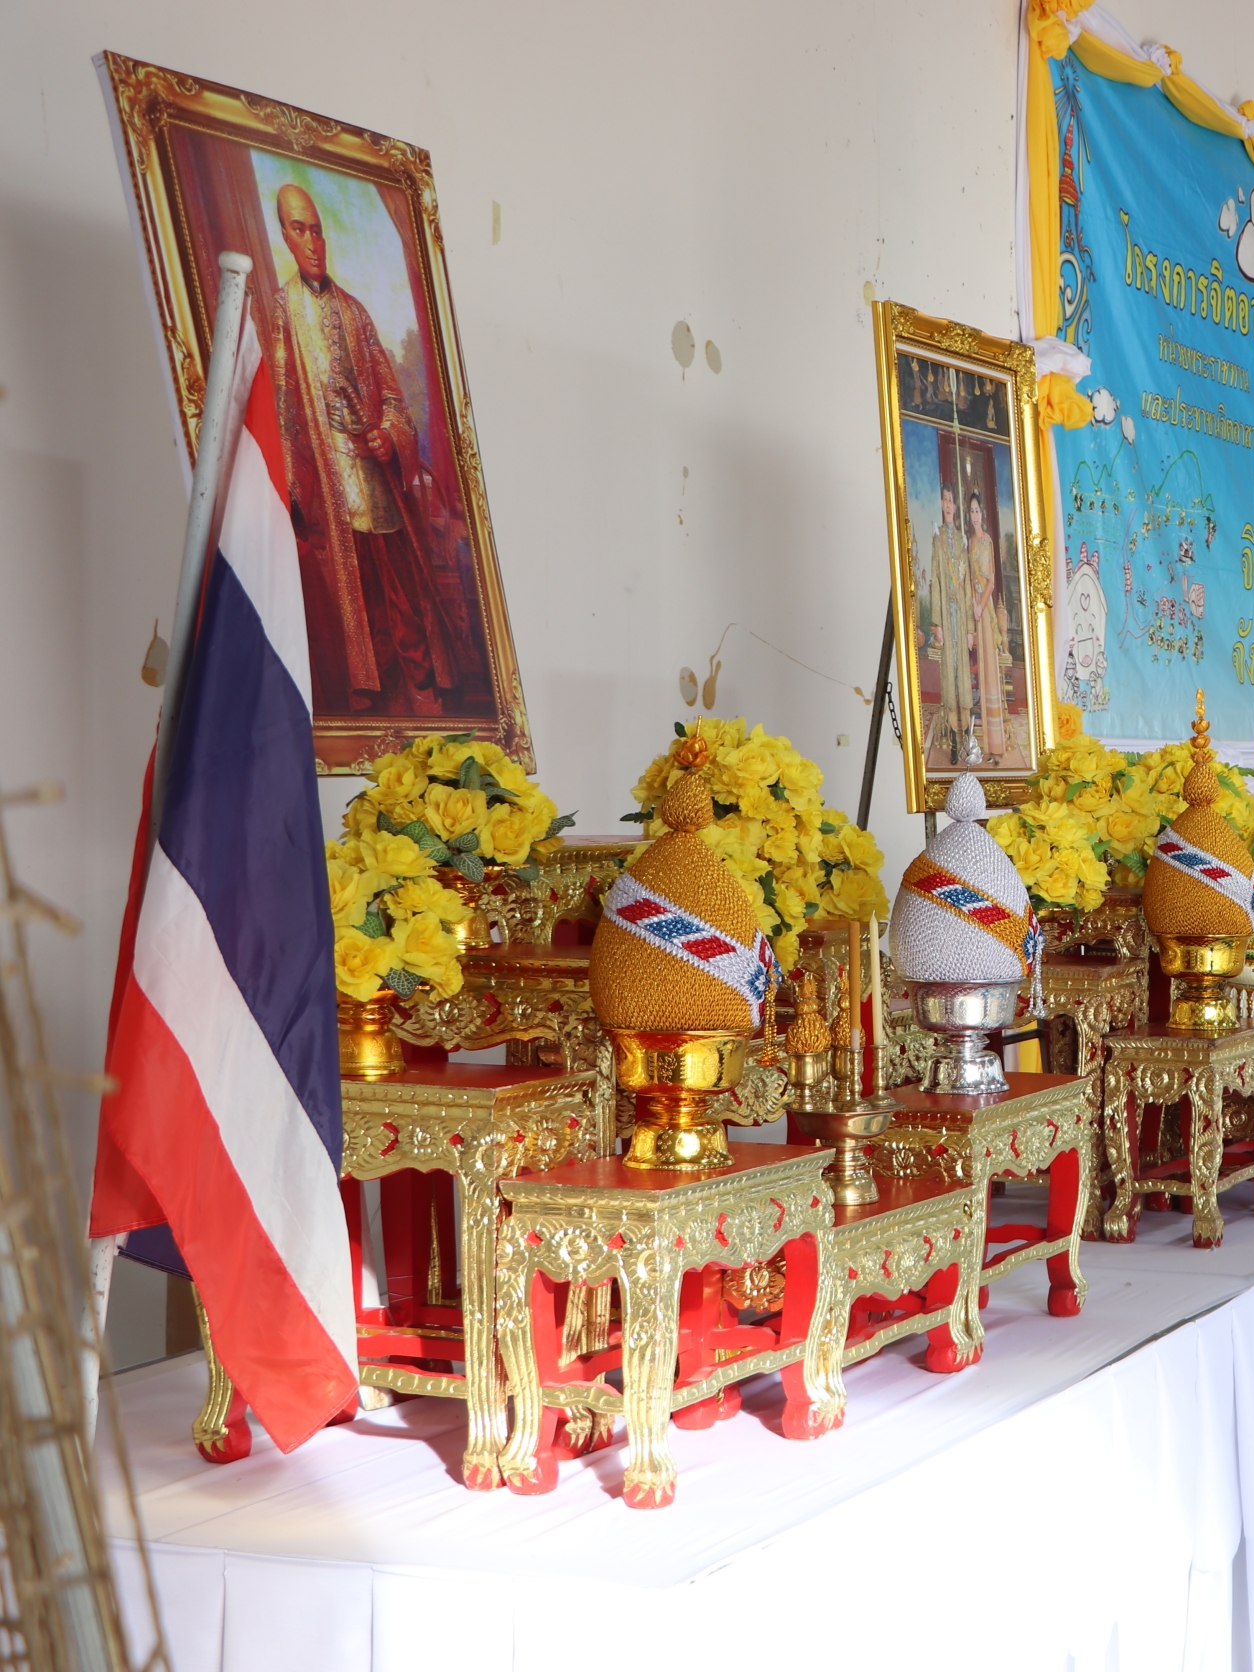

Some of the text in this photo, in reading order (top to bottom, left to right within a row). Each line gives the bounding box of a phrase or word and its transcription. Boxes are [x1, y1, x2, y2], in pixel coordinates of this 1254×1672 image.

[1158, 322, 1251, 394] หน่วยพระราชทาน
